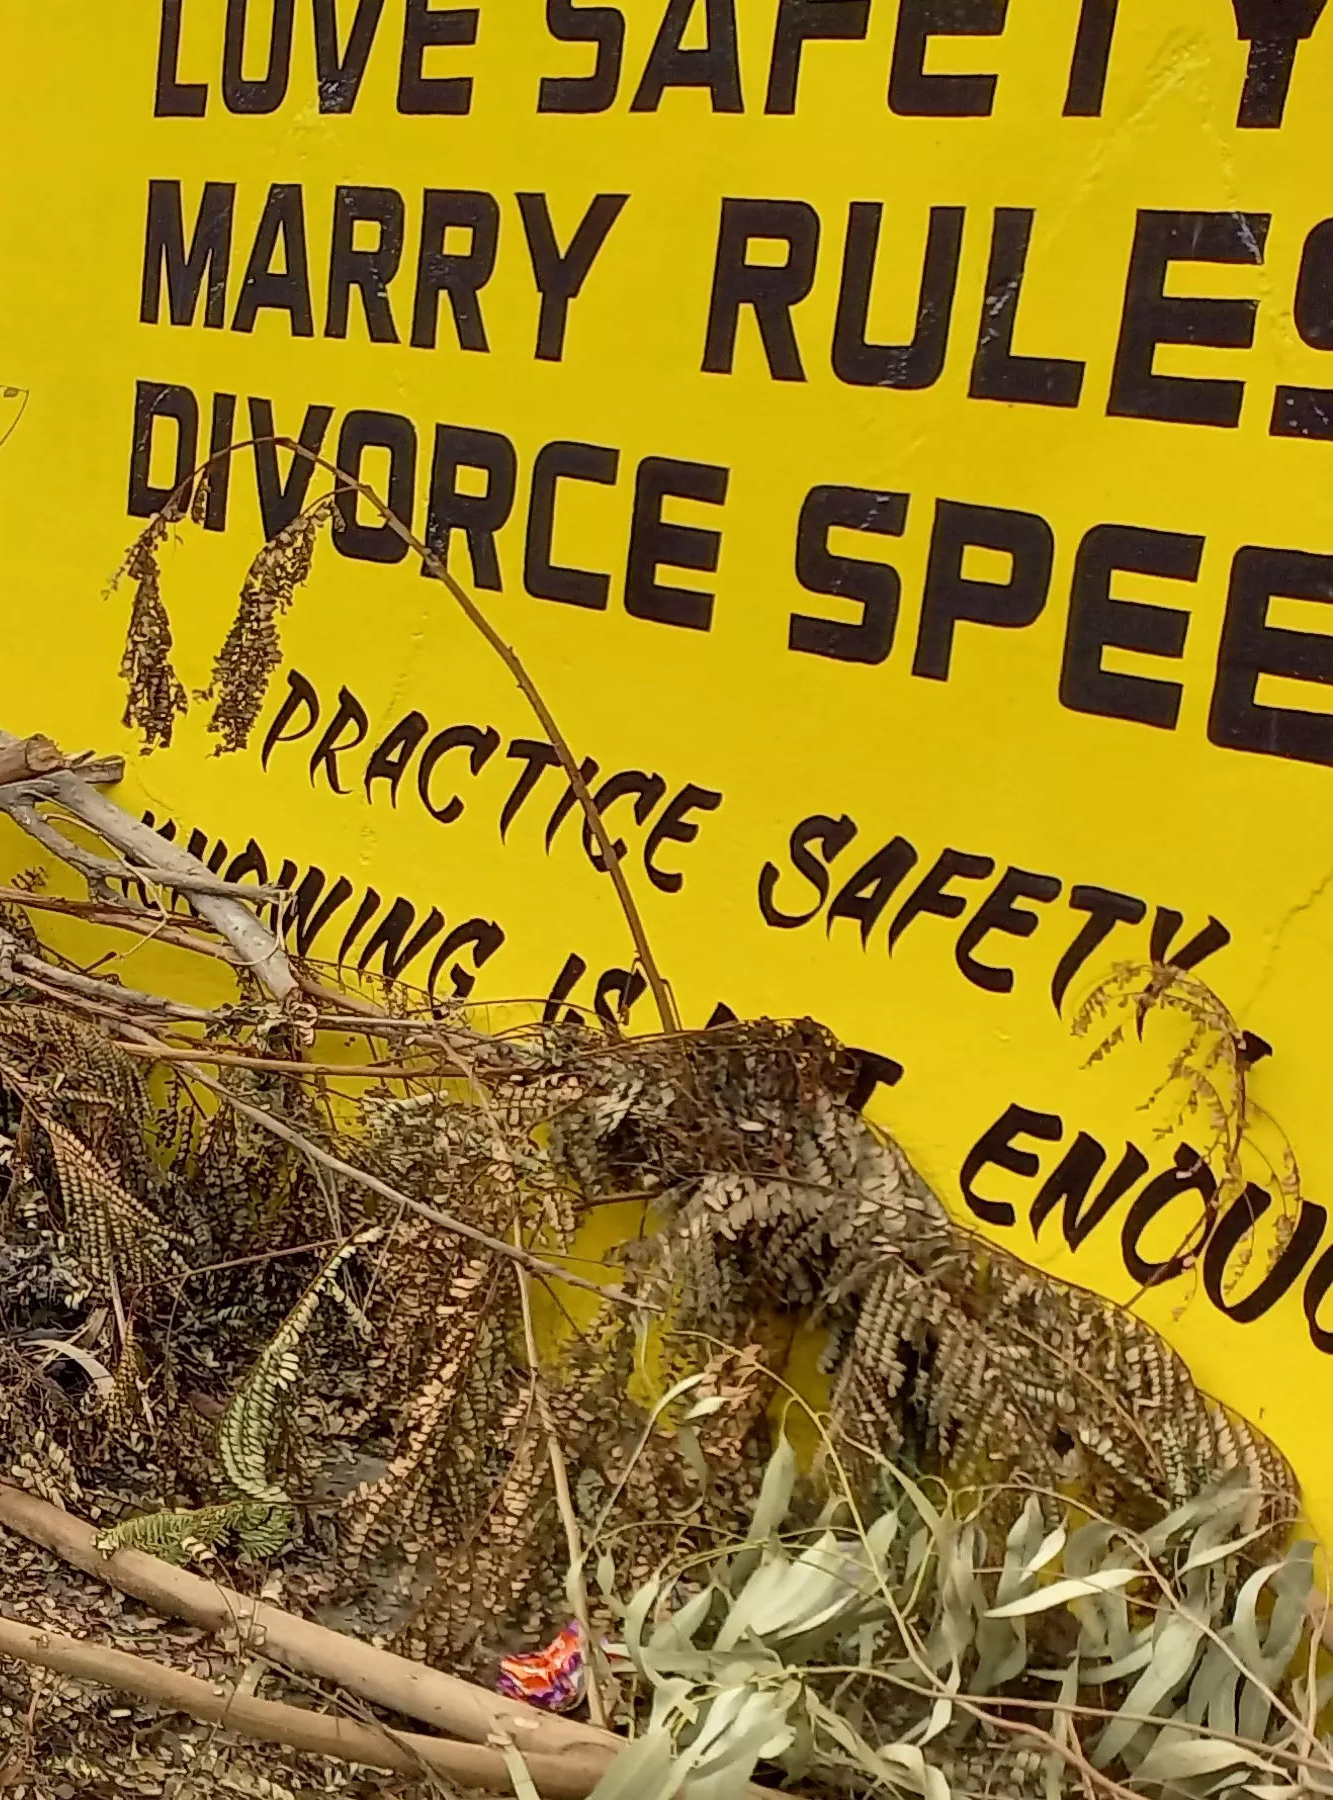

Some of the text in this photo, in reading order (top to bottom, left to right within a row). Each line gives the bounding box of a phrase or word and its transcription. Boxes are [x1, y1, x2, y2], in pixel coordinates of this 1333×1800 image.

[154, 0, 482, 118] LOVE
[139, 179, 631, 363] MARRY
[127, 379, 730, 633] DIVORCE
[261, 668, 723, 893] PRACTICE
